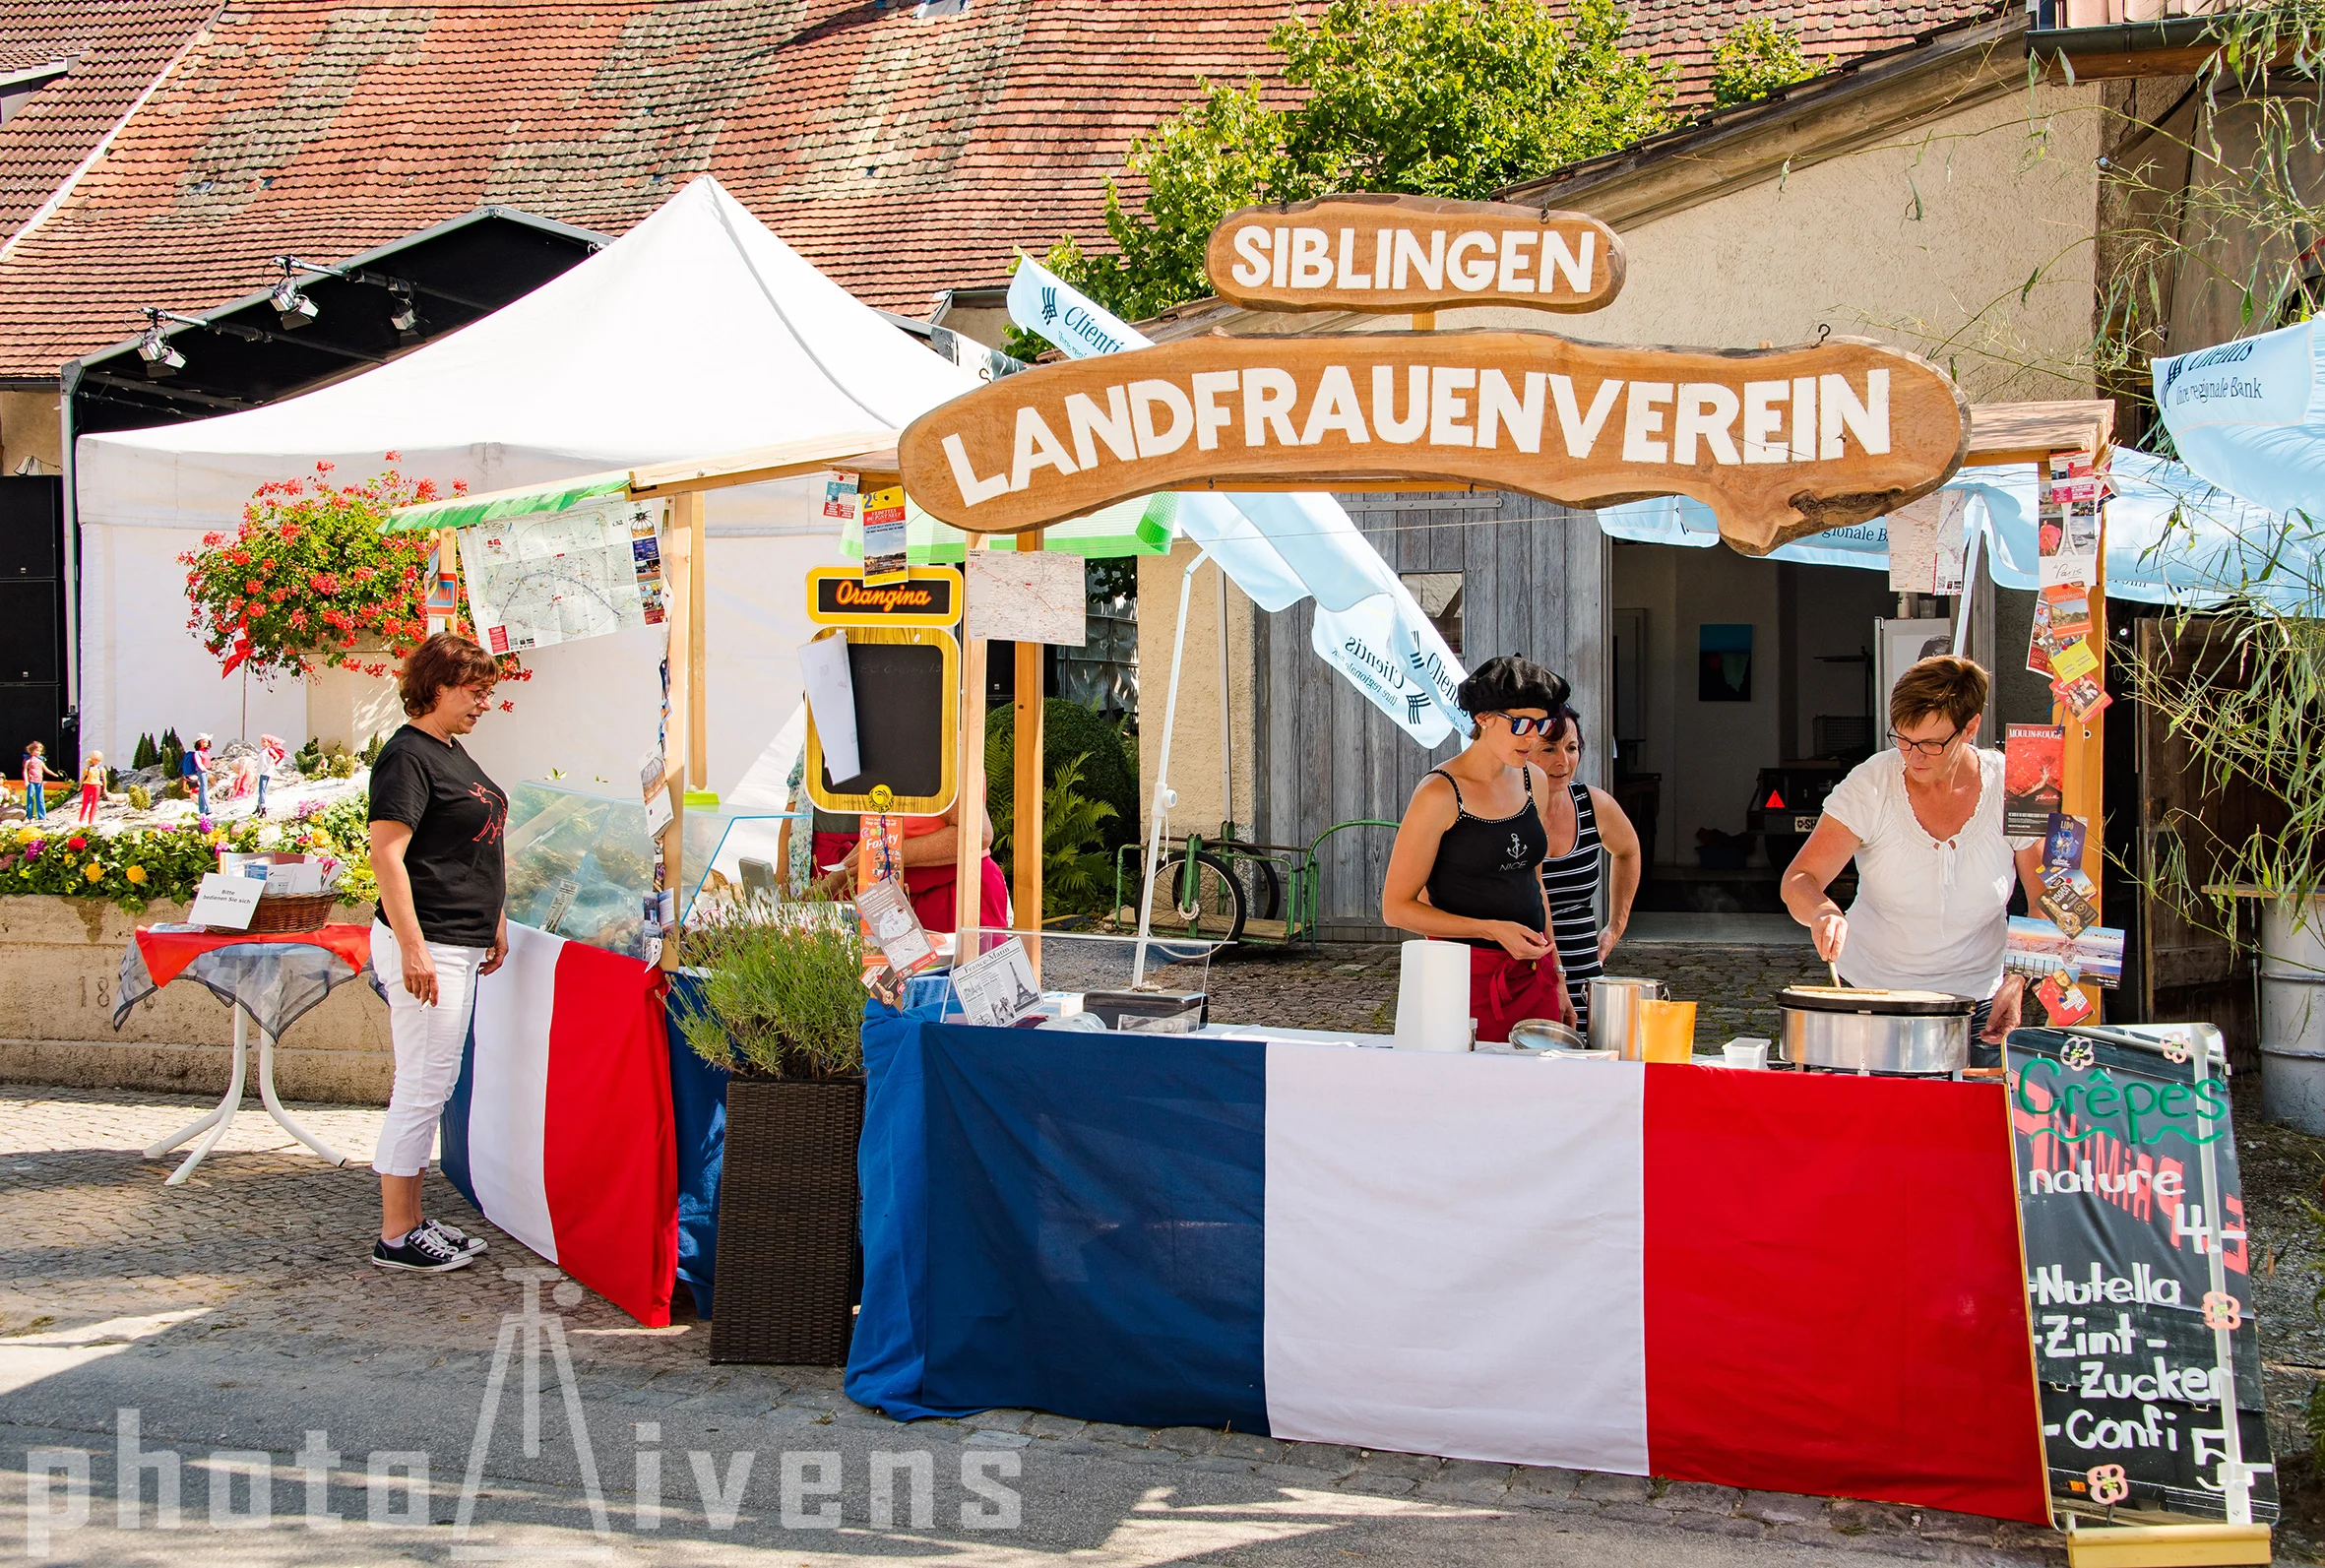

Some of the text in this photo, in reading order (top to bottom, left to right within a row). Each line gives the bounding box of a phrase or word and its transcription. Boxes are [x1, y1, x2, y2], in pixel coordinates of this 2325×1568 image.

[1229, 224, 1596, 295] SIBLINGEN
[1064, 305, 1125, 355] Clienti
[2230, 376, 2263, 399] Bank
[940, 364, 1893, 508] LANDFRAUENVEREIN
[2055, 563, 2082, 579] Paris
[836, 580, 932, 613] Orangina
[964, 946, 1010, 974] France-Matin
[2018, 1057, 2229, 1145] Crêpes
[2029, 1160, 2186, 1195] nature
[2079, 1355, 2232, 1402] Zucker
